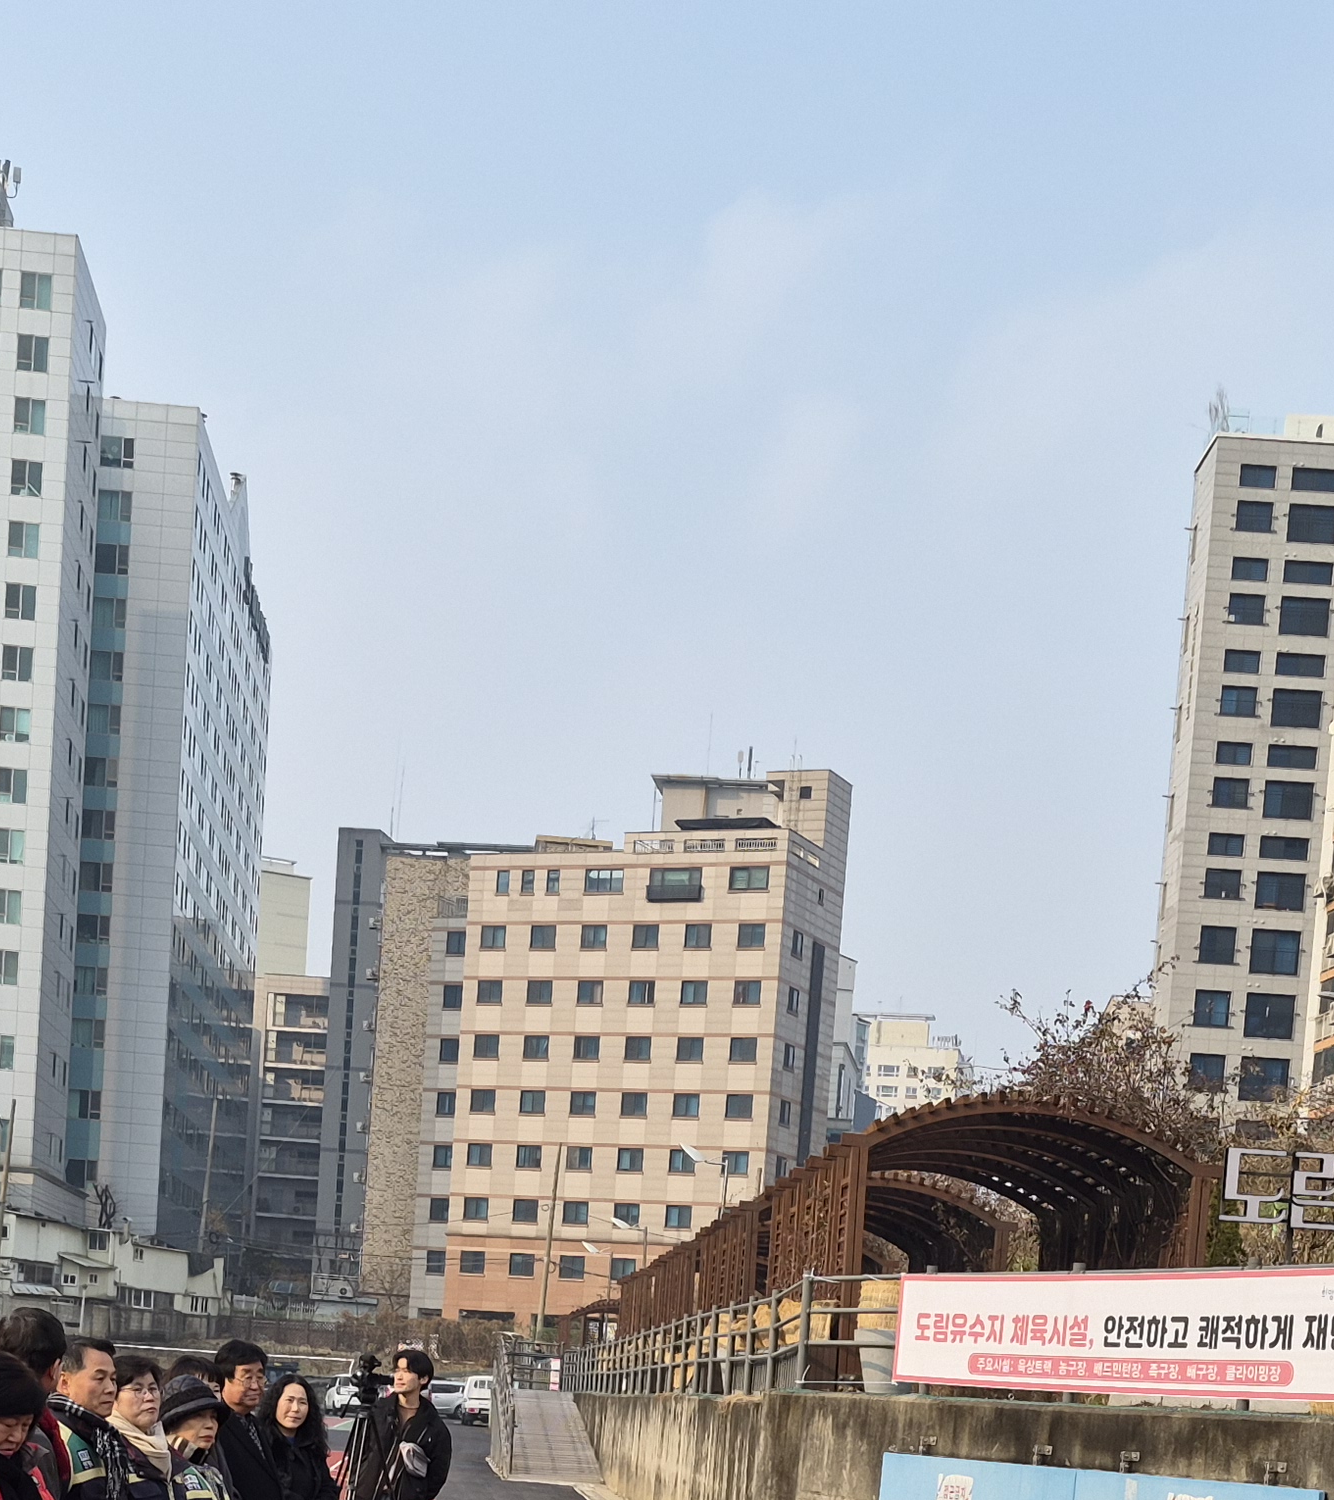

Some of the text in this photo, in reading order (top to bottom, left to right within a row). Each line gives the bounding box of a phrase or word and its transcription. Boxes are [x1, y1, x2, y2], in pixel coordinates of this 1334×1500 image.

[914, 1312, 1005, 1345] 도림유수지
[1010, 1314, 1095, 1350] 체육시설,
[1103, 1313, 1190, 1349] 안전하고
[1197, 1313, 1295, 1351] 쾌적하게
[976, 1357, 1282, 1382] 주요시설: 육상트랙, 농구장, 배드민턴장, 족구장, 배구장, 클라이밍장
